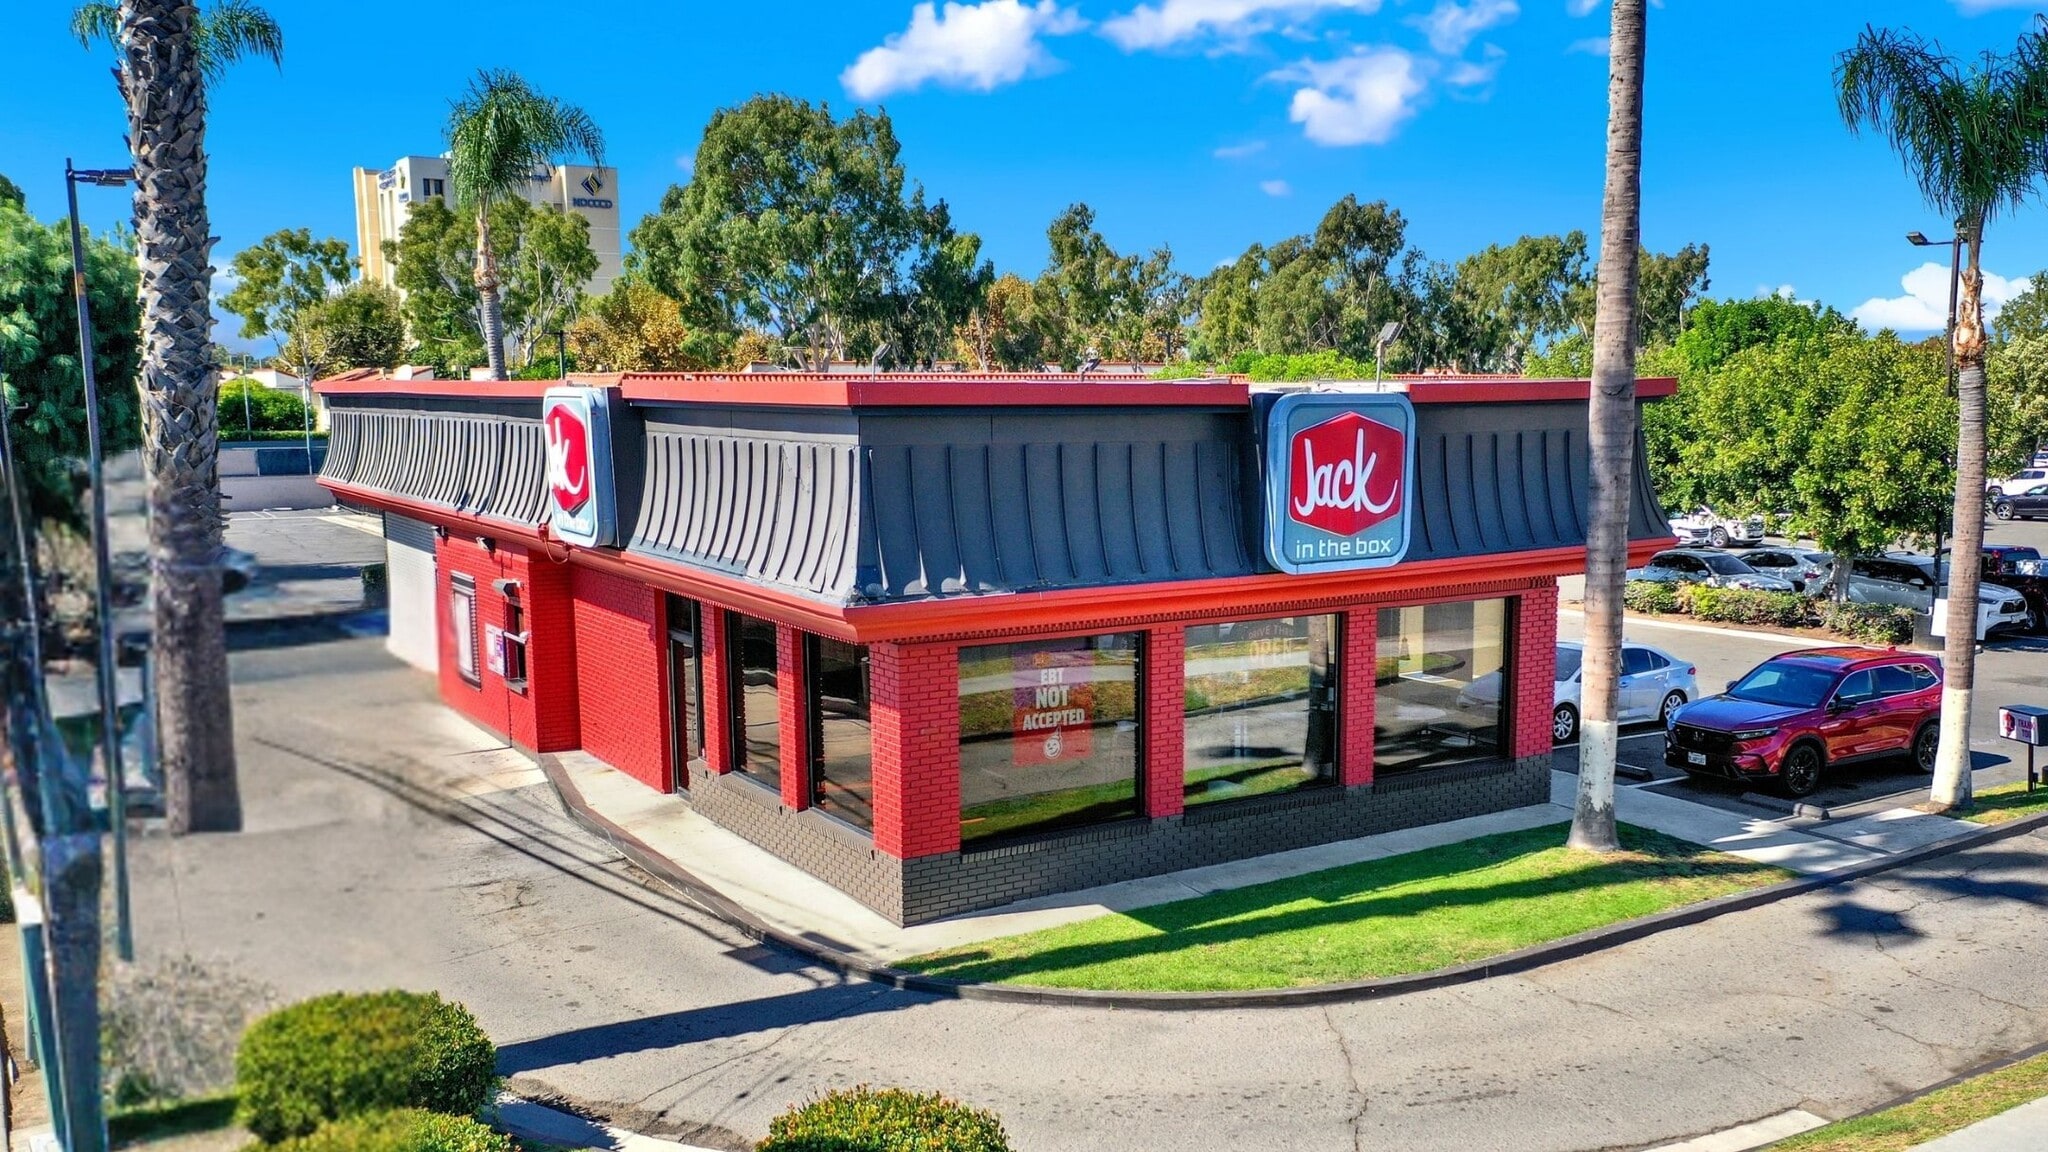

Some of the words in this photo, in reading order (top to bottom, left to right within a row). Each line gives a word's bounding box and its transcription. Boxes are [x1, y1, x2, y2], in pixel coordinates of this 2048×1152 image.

[1295, 428, 1398, 517] Jack
[1296, 540, 1313, 559] in
[1319, 538, 1350, 557] the
[1356, 537, 1392, 555] box
[1040, 668, 1064, 686] EBT
[1036, 685, 1070, 709] NOT
[1023, 708, 1085, 731] ACCEPTED
